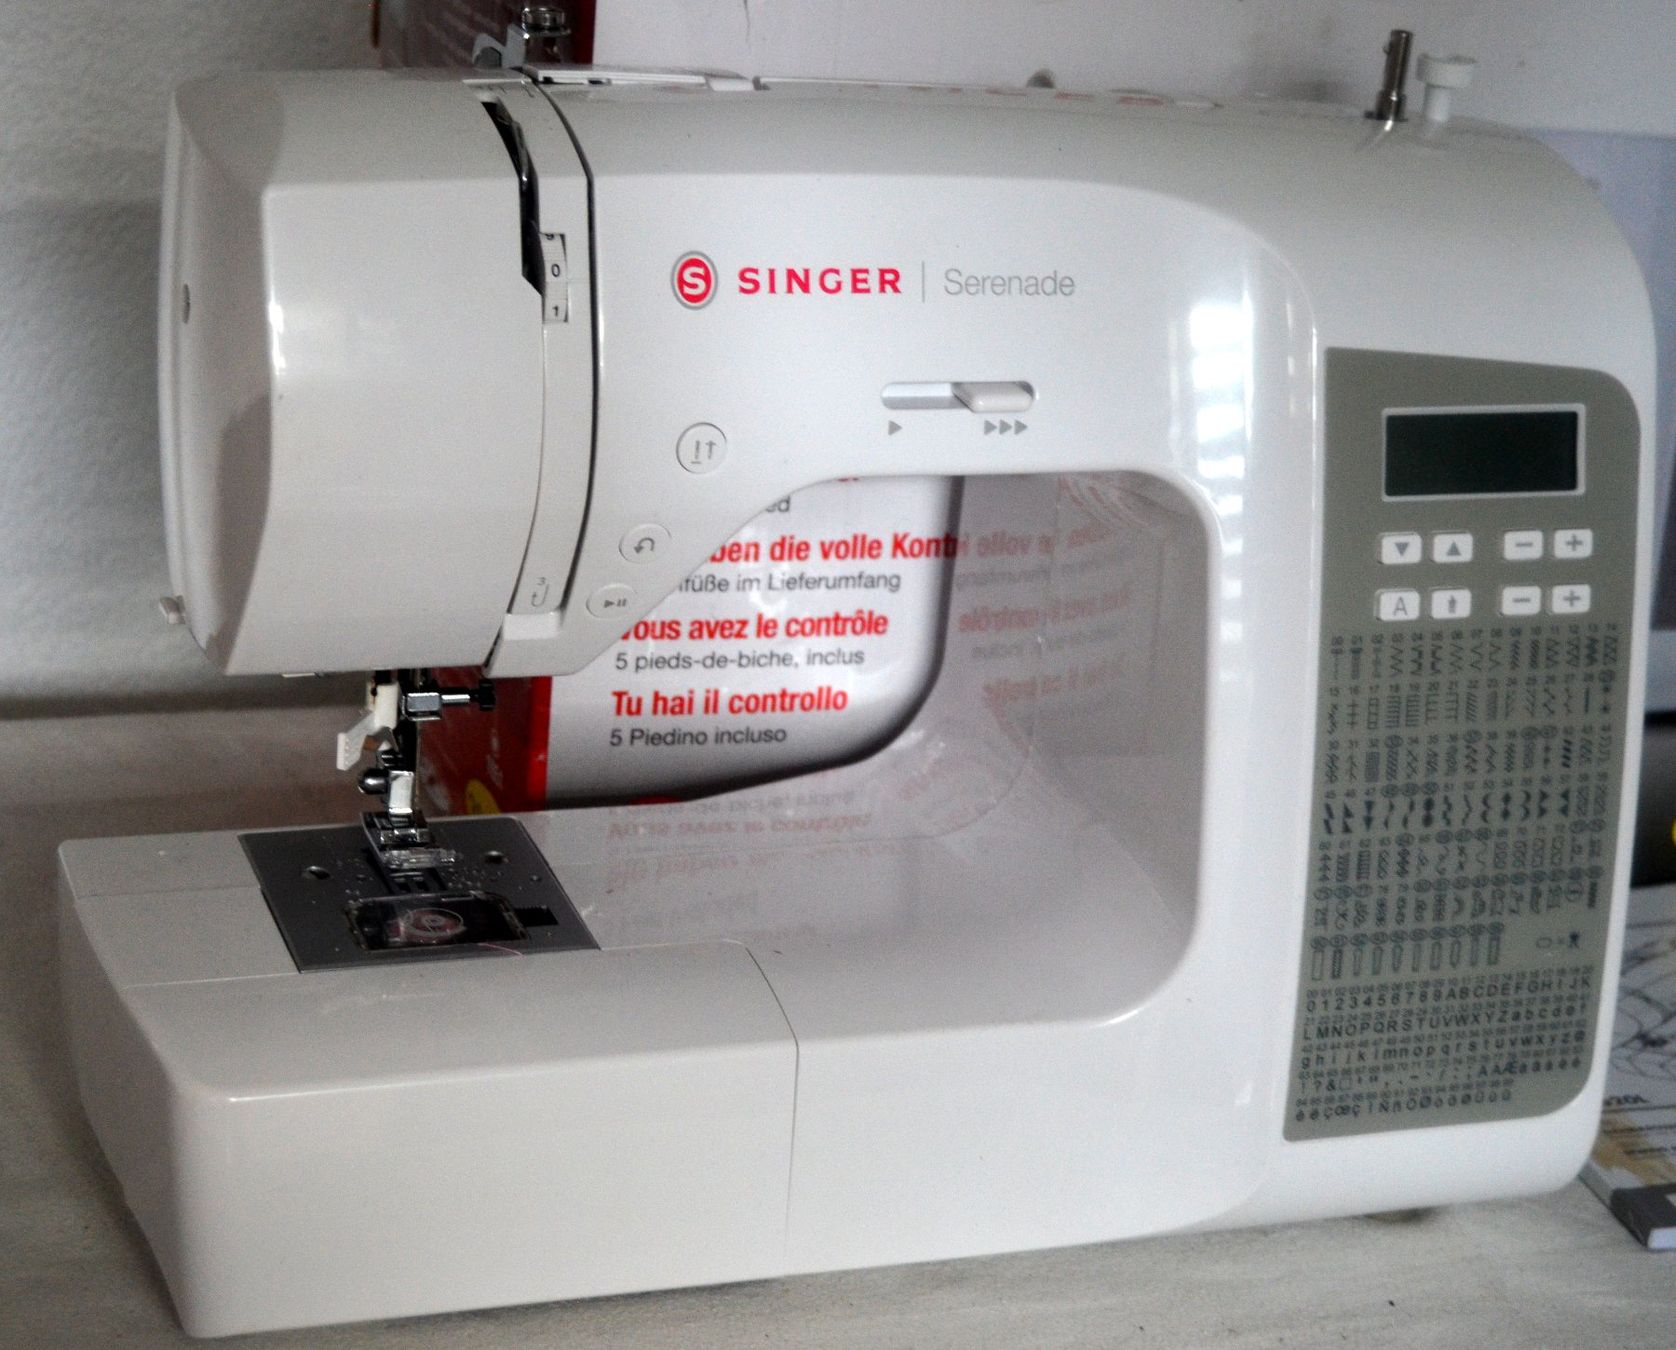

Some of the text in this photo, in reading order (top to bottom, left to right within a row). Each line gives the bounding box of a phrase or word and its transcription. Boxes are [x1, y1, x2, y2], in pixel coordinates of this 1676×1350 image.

[551, 264, 560, 277] 0
[738, 267, 902, 295] SINGER
[944, 268, 1075, 296] Serenade
[552, 305, 558, 317] 1
[769, 535, 811, 562] die
[819, 533, 883, 560] volle
[679, 571, 901, 593] füße im Lieferumfang
[1393, 597, 1408, 616] A
[621, 609, 889, 641] ous avez le contrôle
[616, 647, 865, 673] 5 pieds-de-biche, inclus
[612, 686, 849, 717] Tu hai il controllo
[610, 726, 787, 747] 5 Piedino incluso
